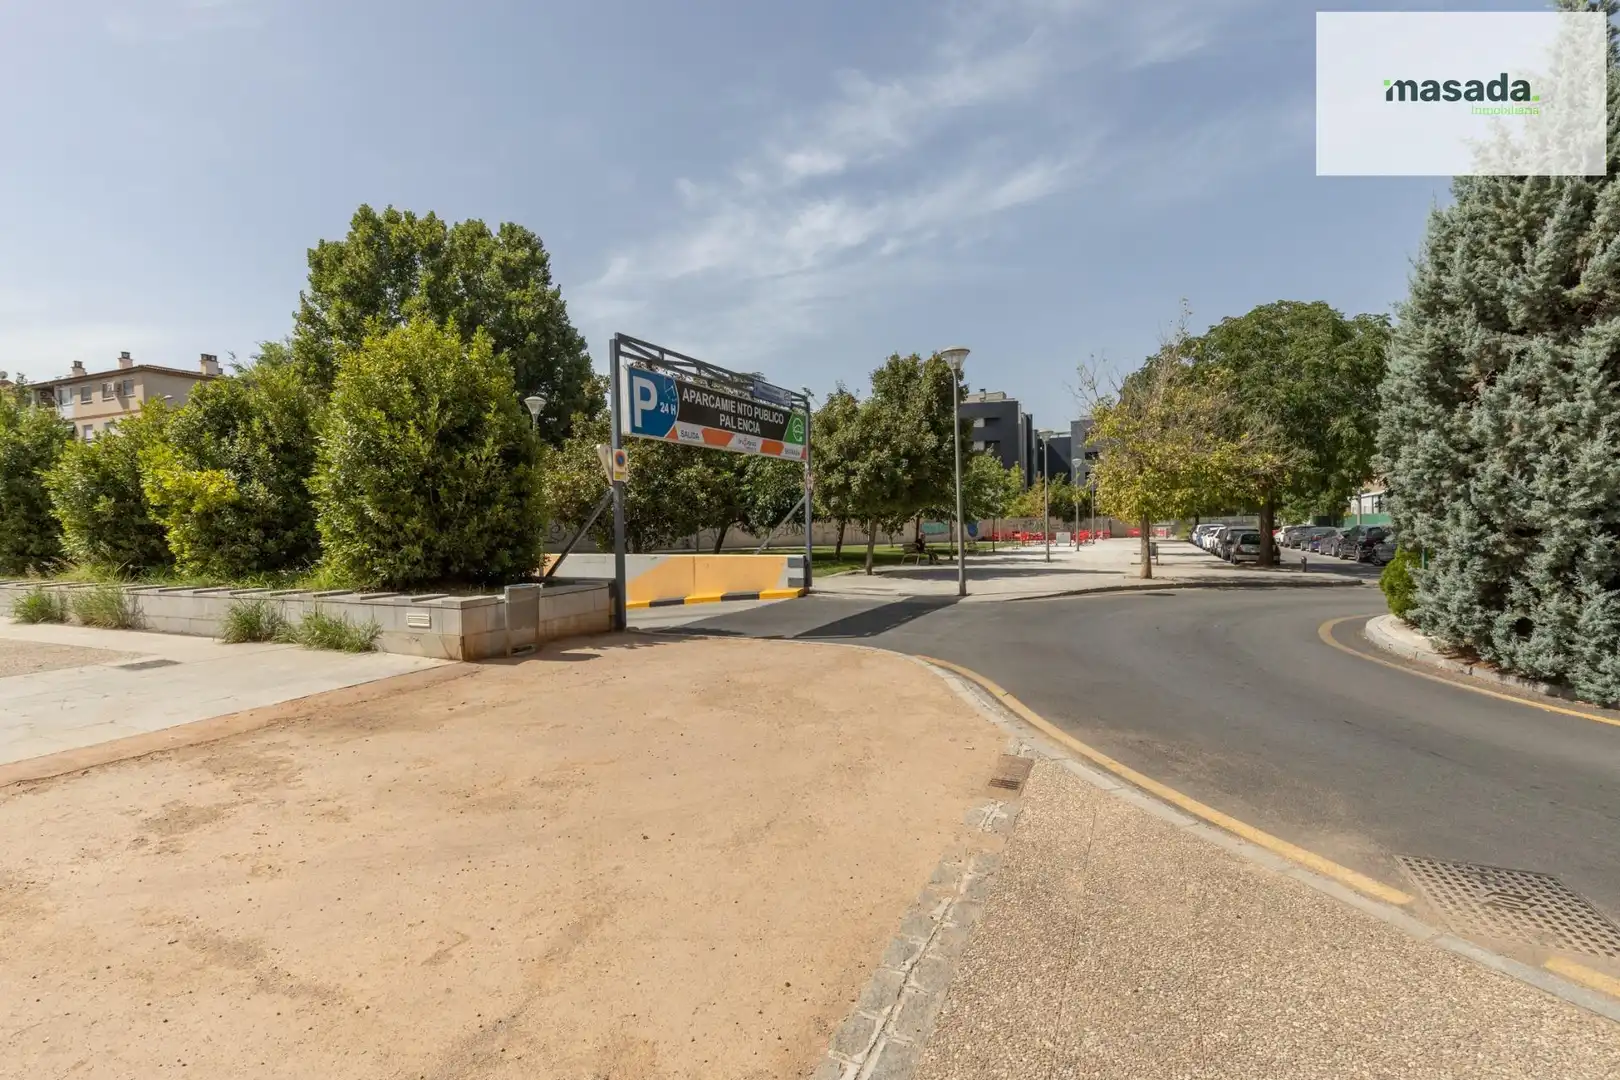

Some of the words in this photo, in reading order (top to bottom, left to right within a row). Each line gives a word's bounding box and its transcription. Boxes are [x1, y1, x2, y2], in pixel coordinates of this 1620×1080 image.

[632, 375, 658, 428] P
[659, 401, 669, 414] 24
[670, 403, 677, 416] H
